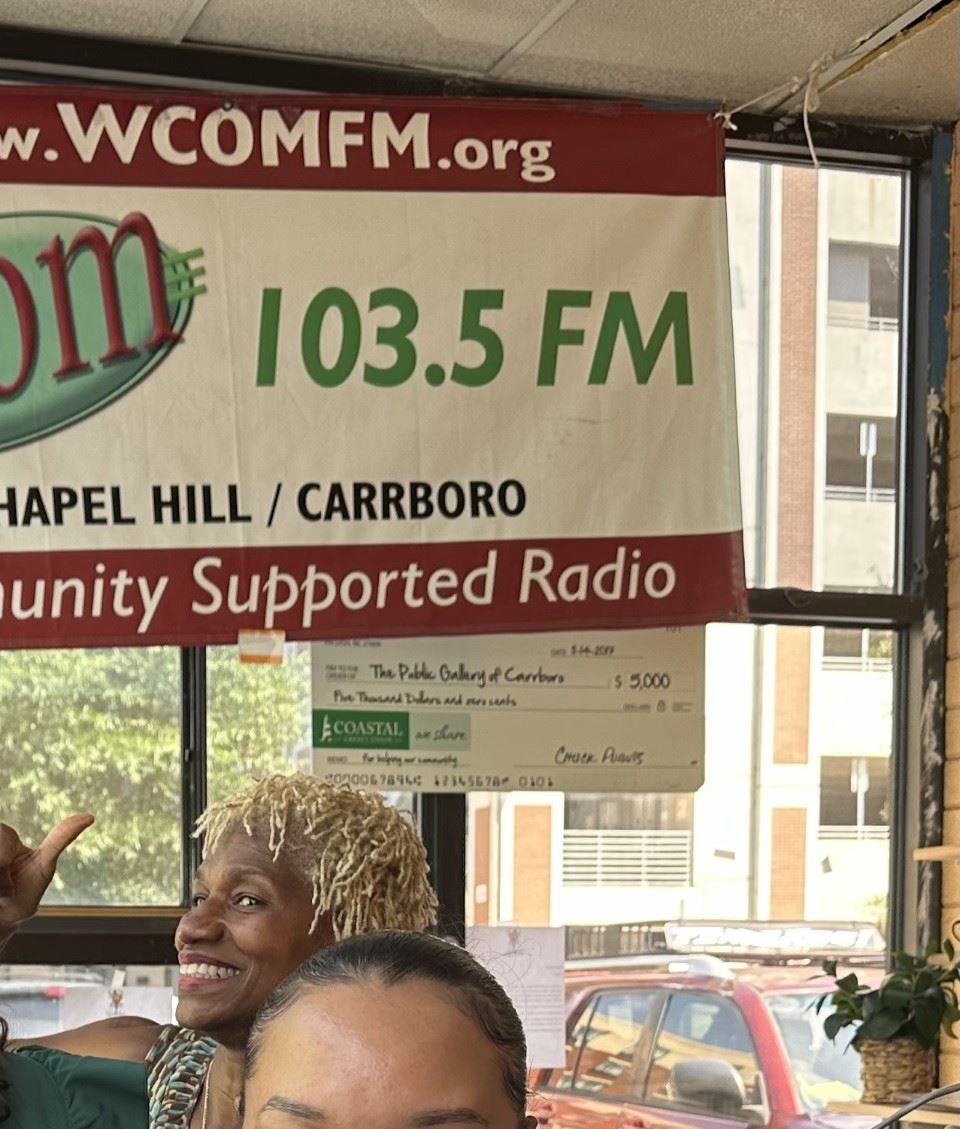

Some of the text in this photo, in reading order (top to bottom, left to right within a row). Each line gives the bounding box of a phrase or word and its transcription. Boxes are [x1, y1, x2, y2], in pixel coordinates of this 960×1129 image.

[256, 287, 694, 389] 103.5 FM
[151, 481, 252, 525] HILL
[296, 478, 527, 524] CARRBORO
[190, 550, 498, 628] Supported
[520, 547, 676, 606] Radio
[369, 664, 396, 680] The
[398, 662, 436, 681] Public
[439, 663, 486, 688] Gallery
[505, 667, 565, 684] Carrboro
[333, 719, 403, 737] COASTAL
